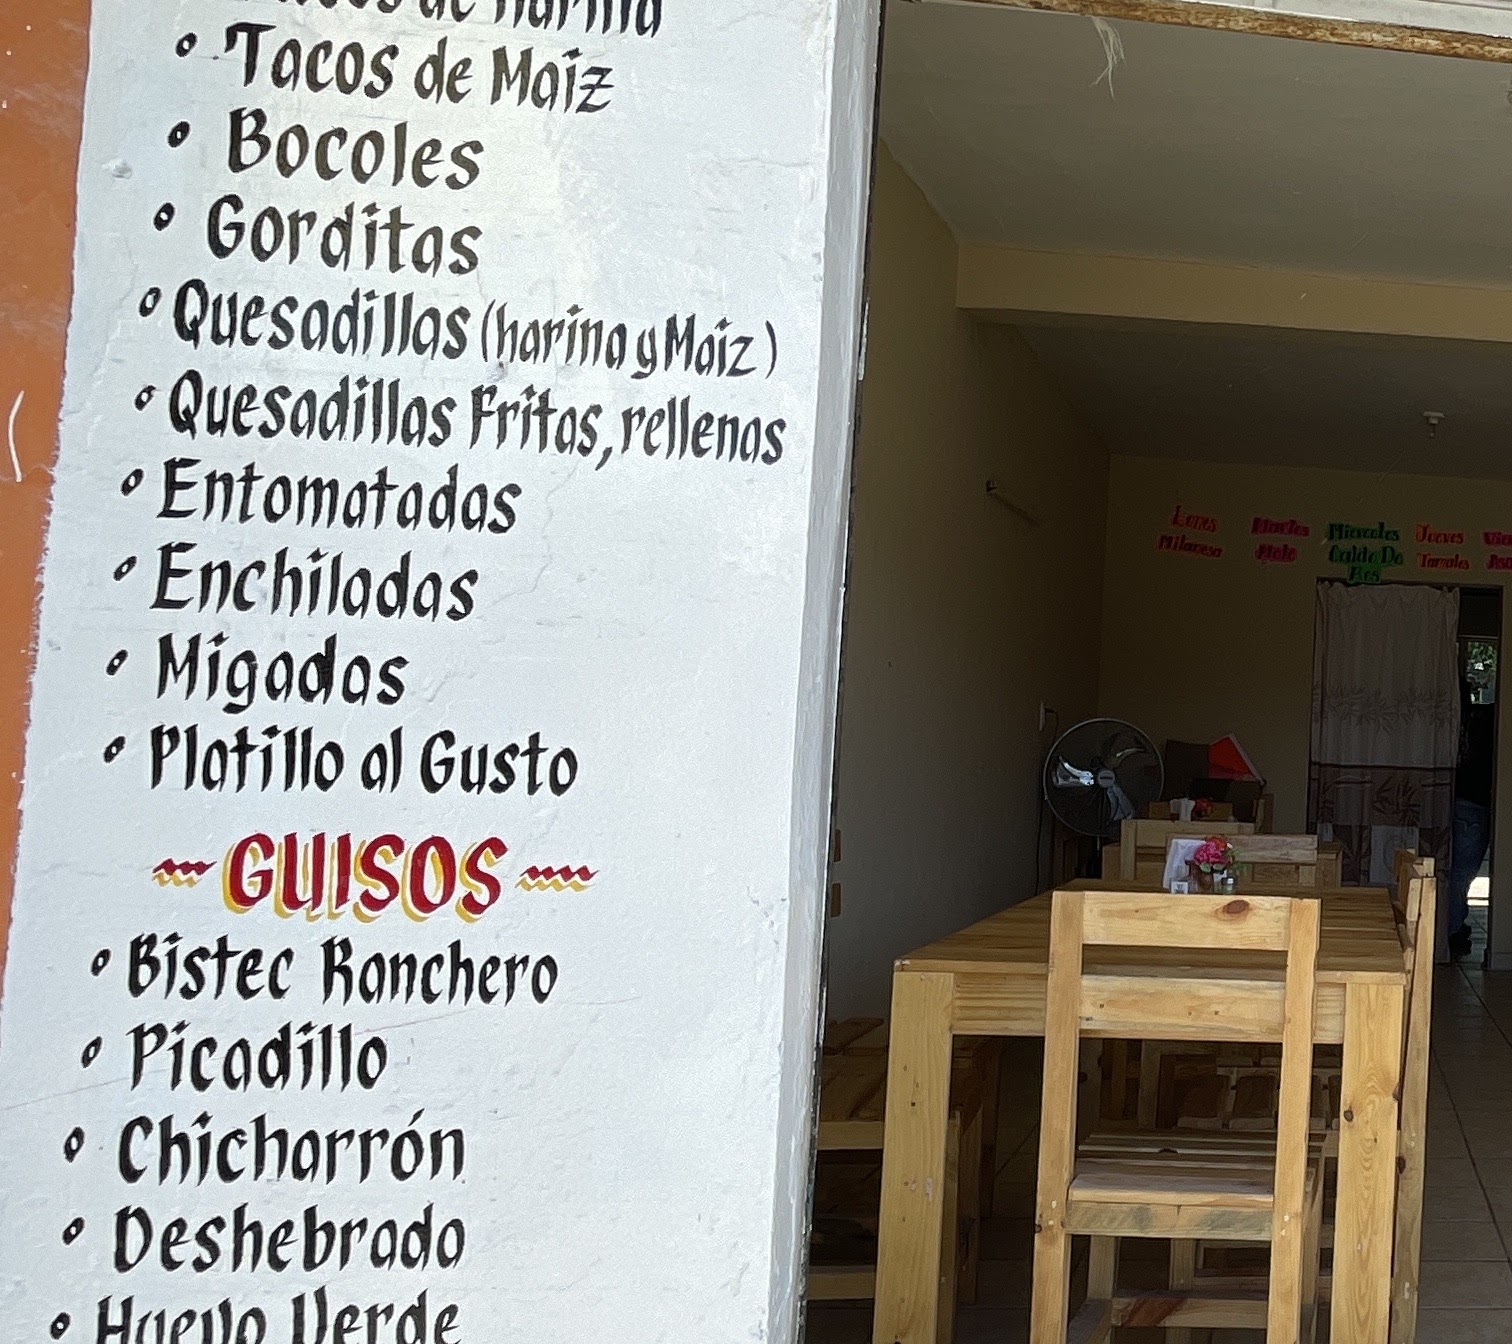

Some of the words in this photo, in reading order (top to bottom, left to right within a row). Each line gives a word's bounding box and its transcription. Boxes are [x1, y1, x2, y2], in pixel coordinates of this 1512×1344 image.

[224, 21, 399, 97] Tacos
[414, 38, 473, 105] de
[490, 45, 616, 114] Maiz
[227, 107, 485, 191] Bocoles
[207, 194, 483, 277] Gorditas
[173, 278, 470, 361] Quesadillas
[480, 298, 627, 370] (harina
[633, 340, 658, 379] y
[167, 368, 456, 448] Quesadillas
[469, 383, 613, 471] Fritas,
[621, 394, 787, 466] rellenas
[156, 456, 522, 533] Entomatadas
[150, 541, 480, 623] Enchiladas
[156, 633, 410, 714] Migadas
[150, 724, 345, 795] Platillo
[359, 726, 402, 795] al
[420, 732, 579, 798] Gusto
[224, 832, 511, 923] GUISOS
[128, 933, 295, 1003] Bistec
[321, 934, 559, 1007] Ranchero
[128, 1022, 388, 1094] Picadillo
[117, 1108, 466, 1186] Chicharrón
[112, 1200, 466, 1274] Deshebrada
